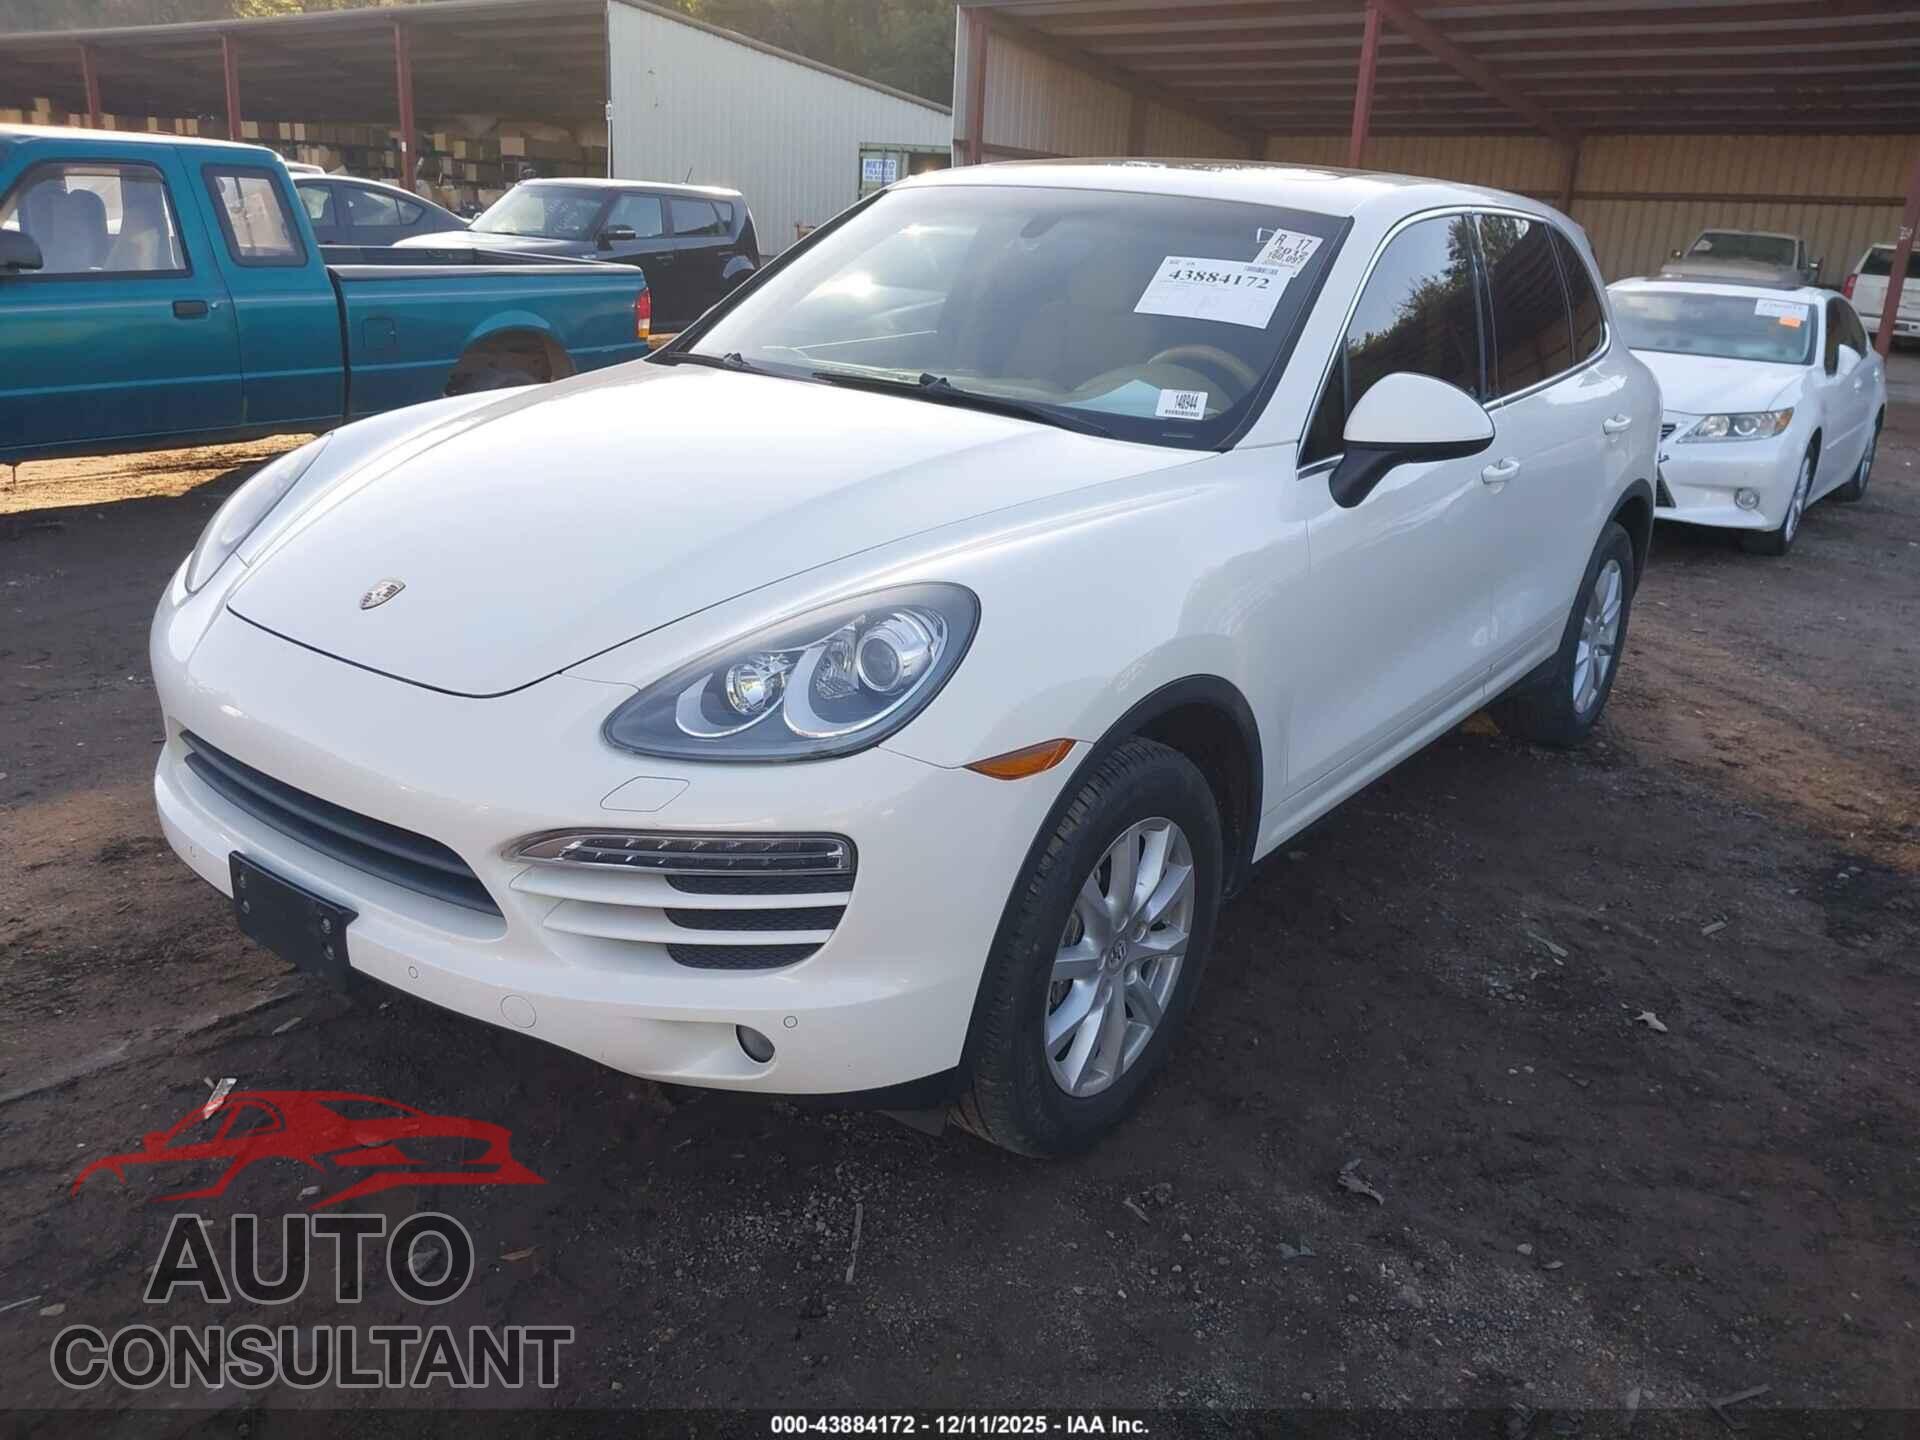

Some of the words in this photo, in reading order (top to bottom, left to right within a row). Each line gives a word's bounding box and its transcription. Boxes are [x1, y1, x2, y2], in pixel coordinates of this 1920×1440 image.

[1274, 233, 1288, 247] R
[1295, 239, 1313, 251] 17
[1168, 269, 1270, 289] 43884172
